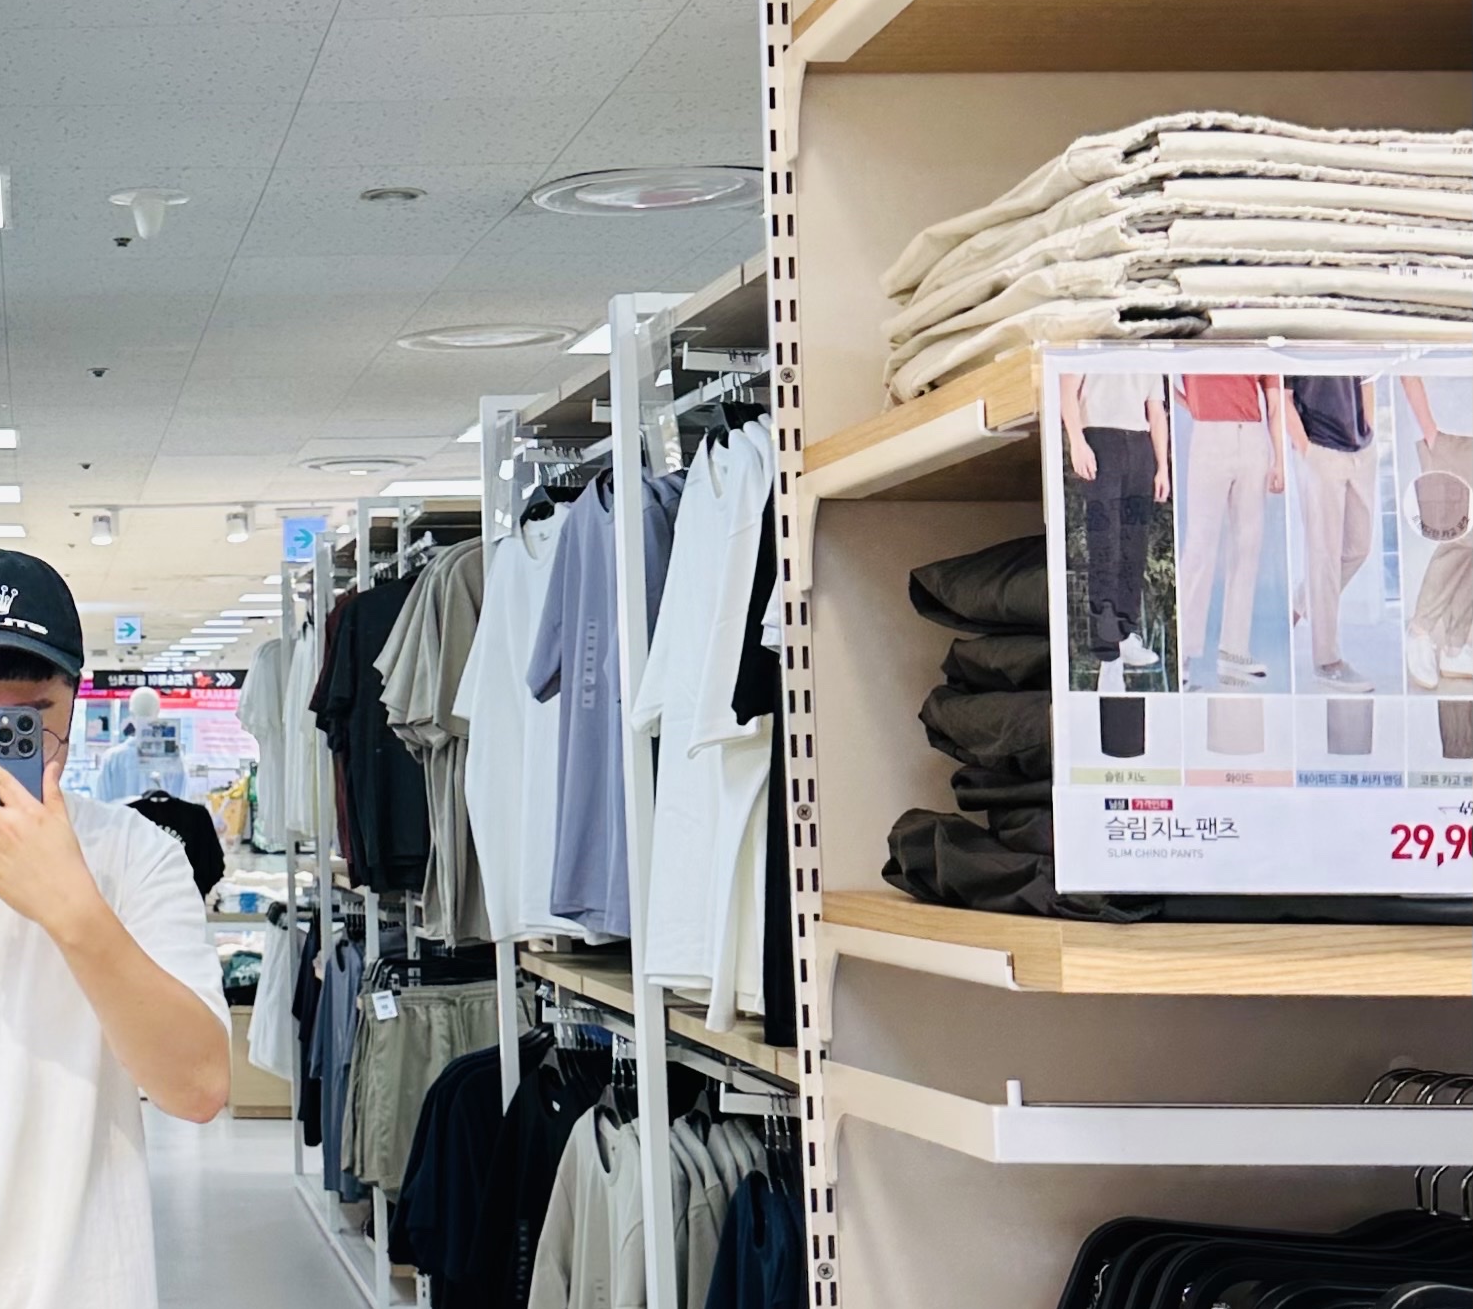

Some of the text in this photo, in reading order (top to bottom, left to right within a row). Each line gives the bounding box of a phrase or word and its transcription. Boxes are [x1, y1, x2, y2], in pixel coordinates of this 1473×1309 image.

[1225, 772, 1255, 784] 와이드
[1104, 816, 1240, 841] 슬림 치노 팬츠
[1107, 848, 1204, 859] SLIM CHINO PANTS
[1390, 824, 1473, 868] 29,9
